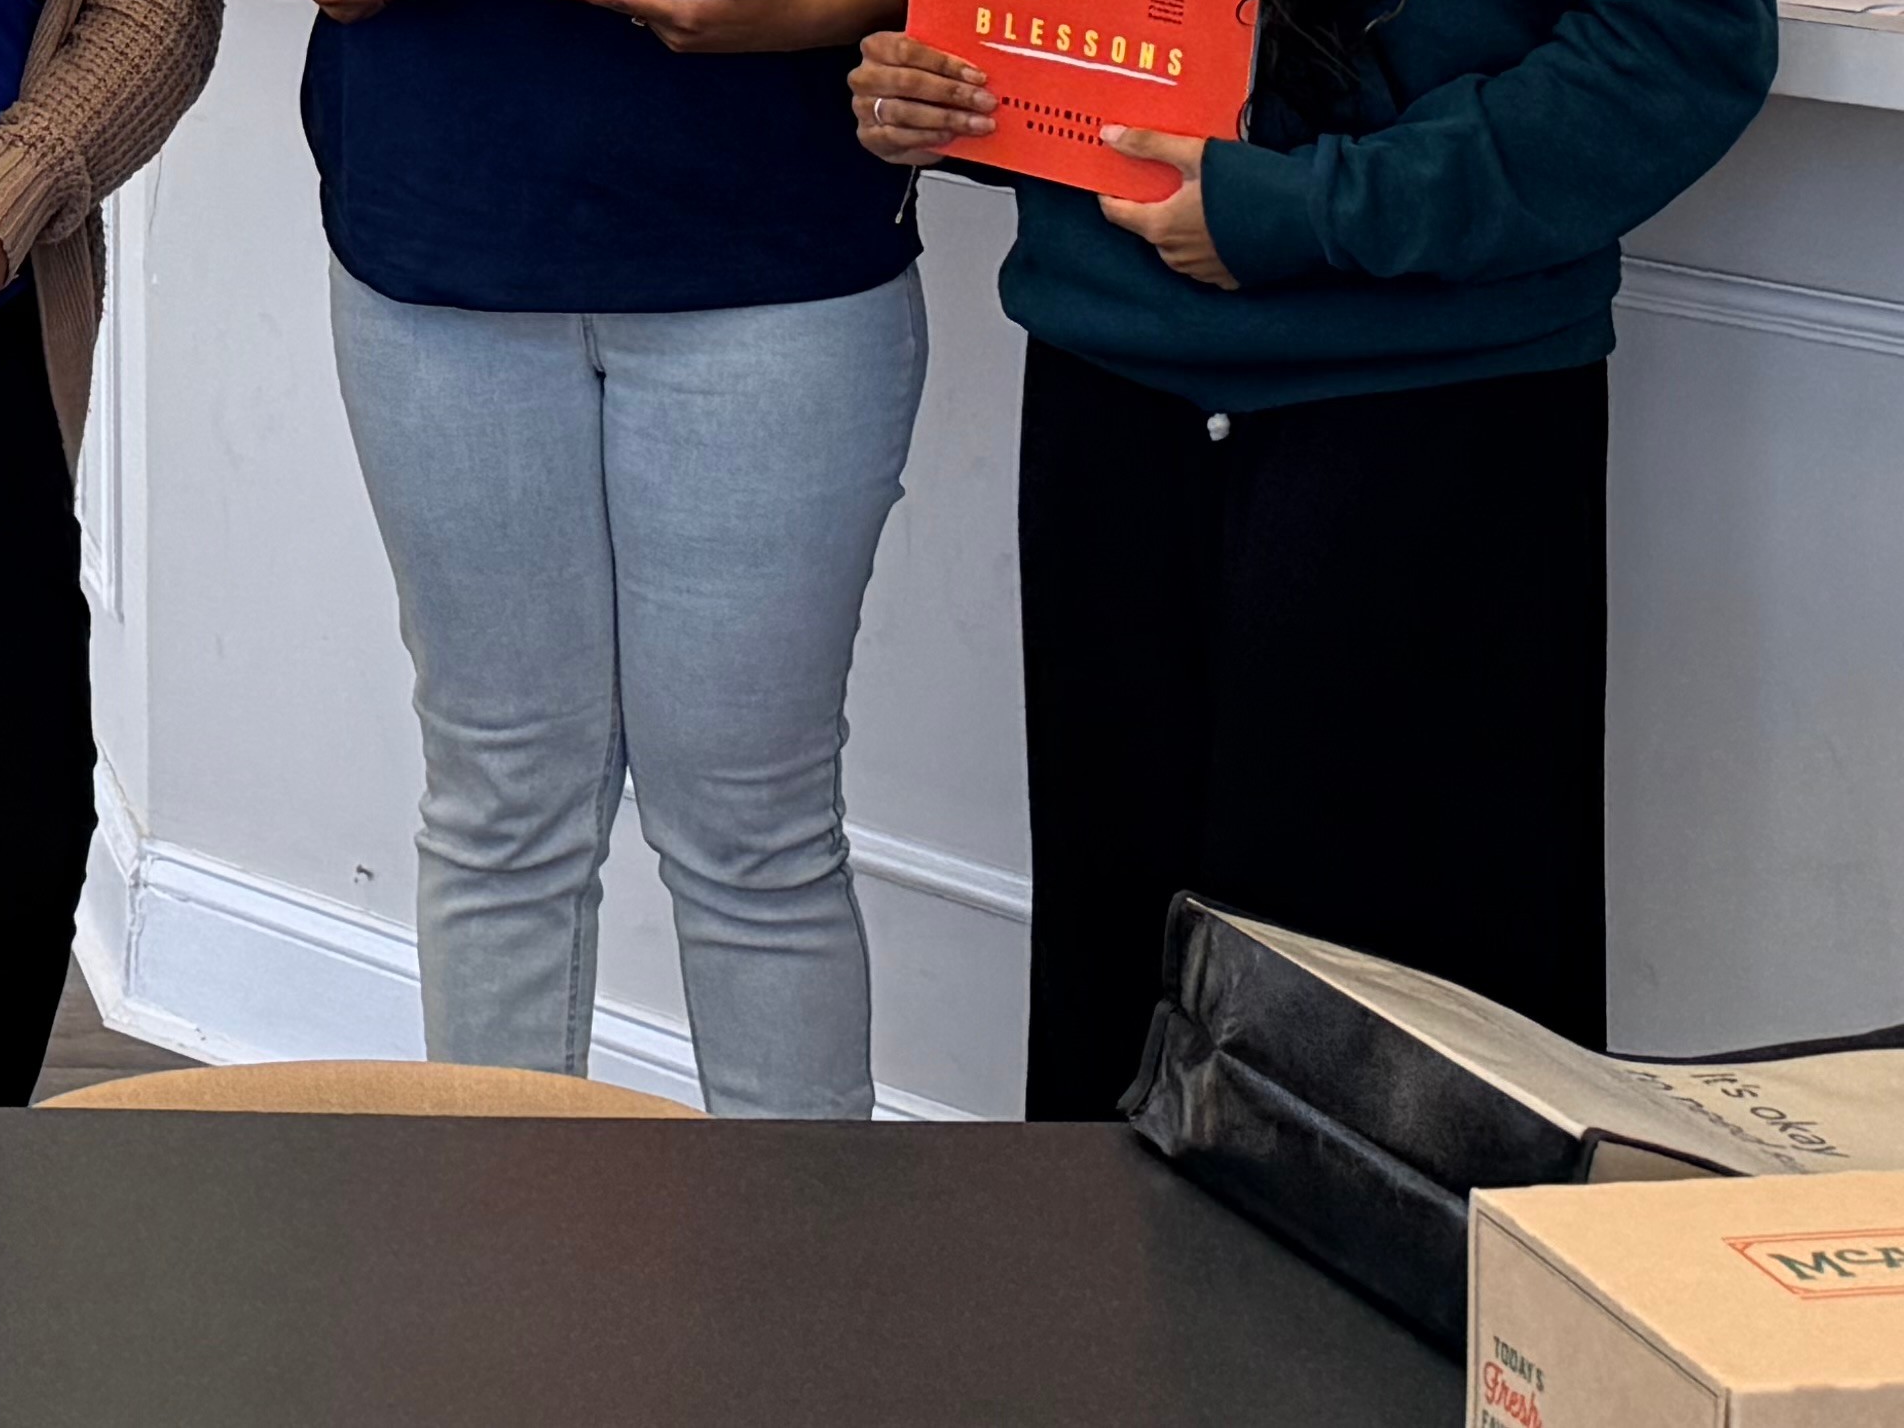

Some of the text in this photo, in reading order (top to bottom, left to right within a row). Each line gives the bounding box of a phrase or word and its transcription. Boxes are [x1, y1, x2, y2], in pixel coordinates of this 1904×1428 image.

[975, 7, 1184, 76] BLESSONS
[1749, 1104, 1851, 1159] okay
[1493, 1335, 1545, 1392] TODAY'S
